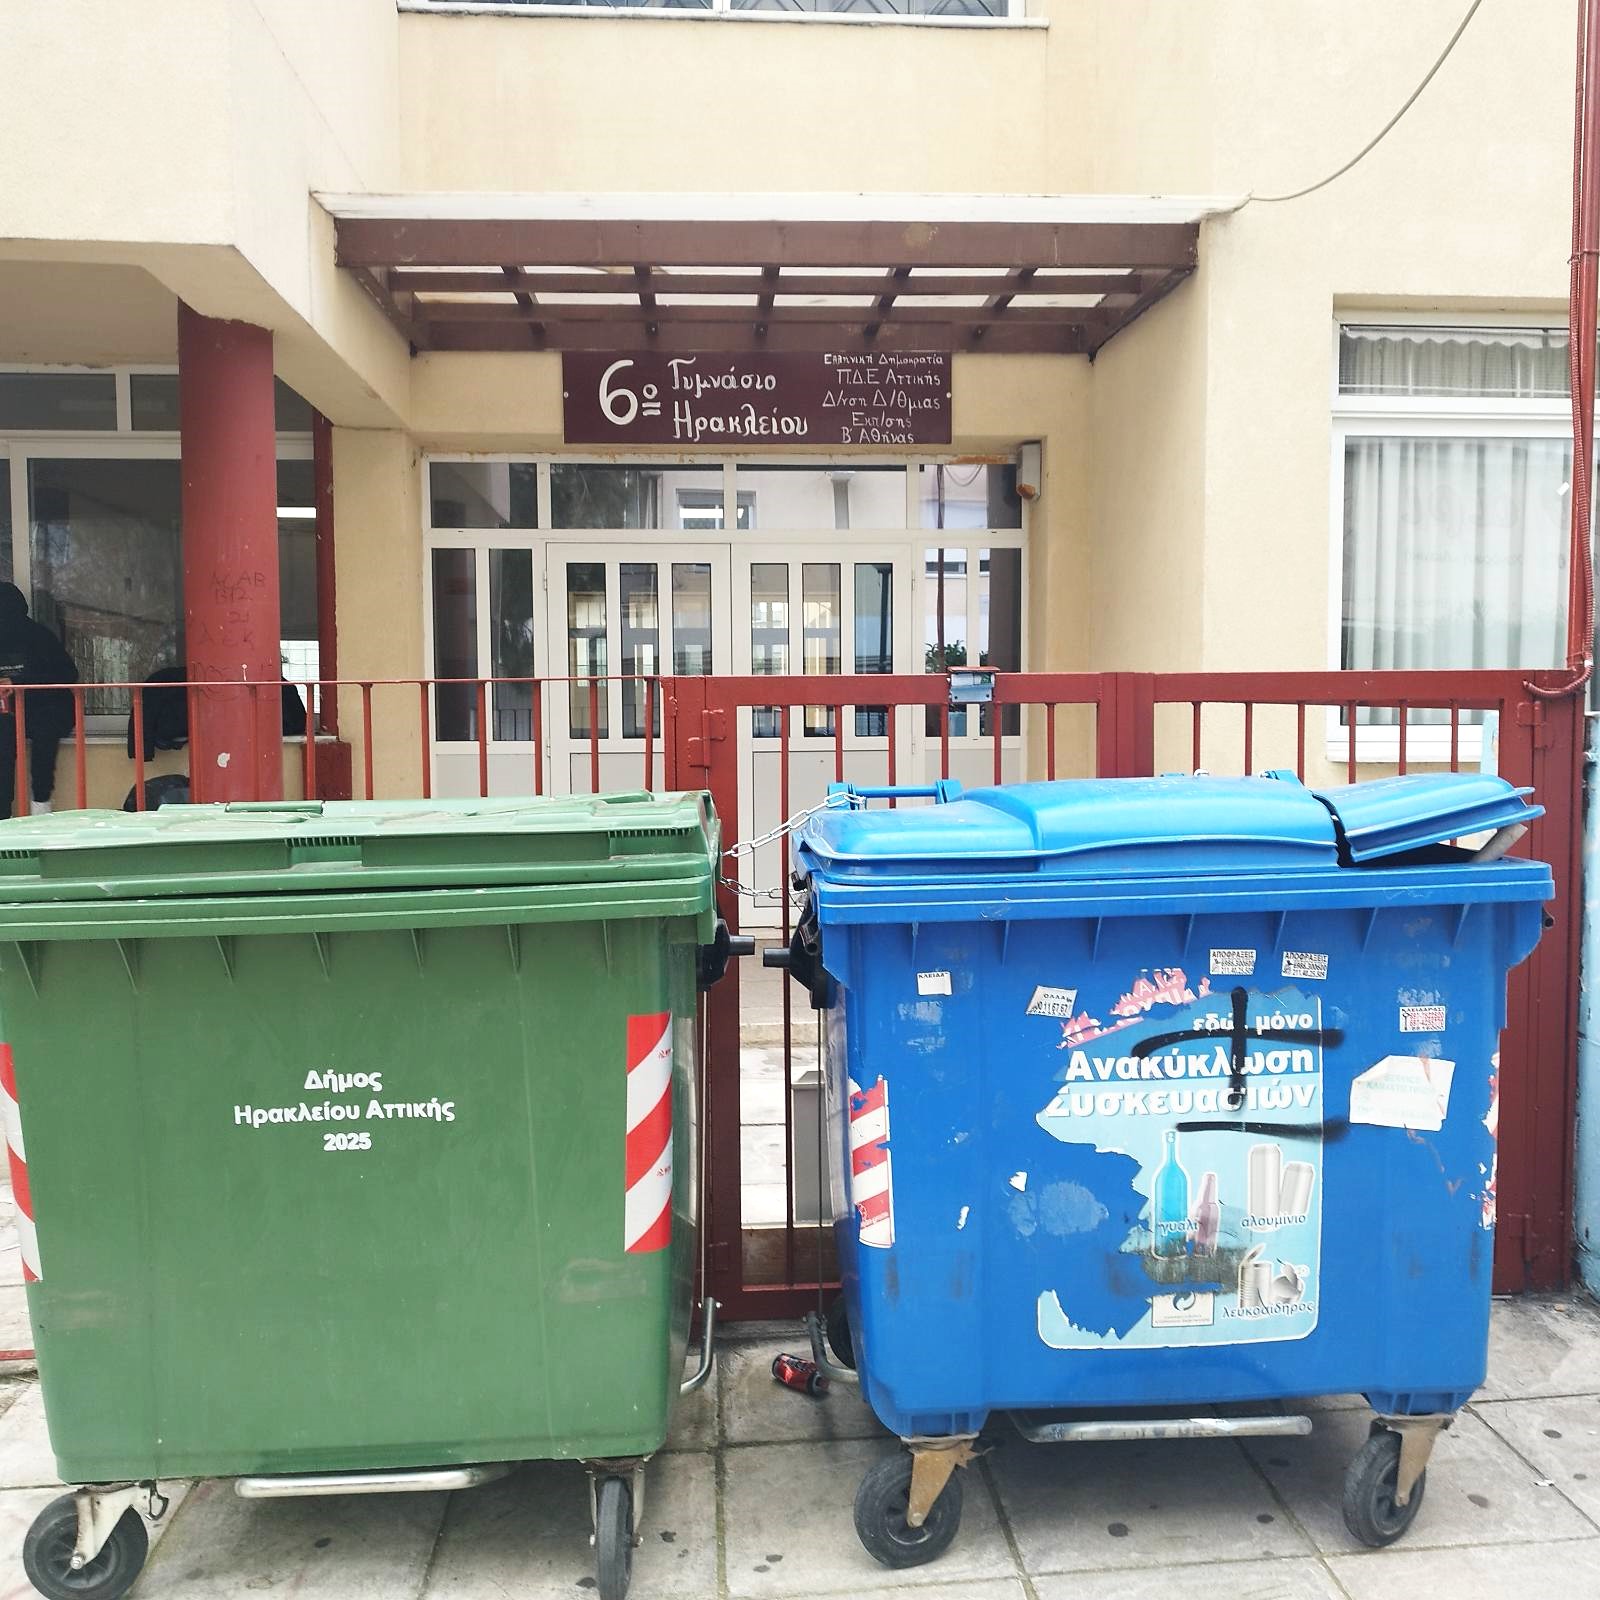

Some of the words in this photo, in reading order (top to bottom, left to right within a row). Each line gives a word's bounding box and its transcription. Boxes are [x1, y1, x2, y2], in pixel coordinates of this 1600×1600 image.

[878, 353, 944, 368] Δημοκρατία
[667, 356, 777, 398] Γυμνάσιο
[885, 368, 941, 386] Αττικής
[822, 389, 867, 407] Δ/νση
[873, 388, 941, 417] Δ/θμιας
[672, 399, 808, 442] Ηρακλείου
[851, 410, 912, 428] Εκπ/σης
[858, 427, 914, 444] Αθήνας
[1255, 1013, 1313, 1035] μόνο
[304, 1068, 383, 1093] Δήμος
[234, 1101, 361, 1128] Ηρακλείου
[365, 1097, 456, 1122] Αττικής
[323, 1131, 372, 1151] 2025
[1241, 1213, 1307, 1230] αλουμίνιο
